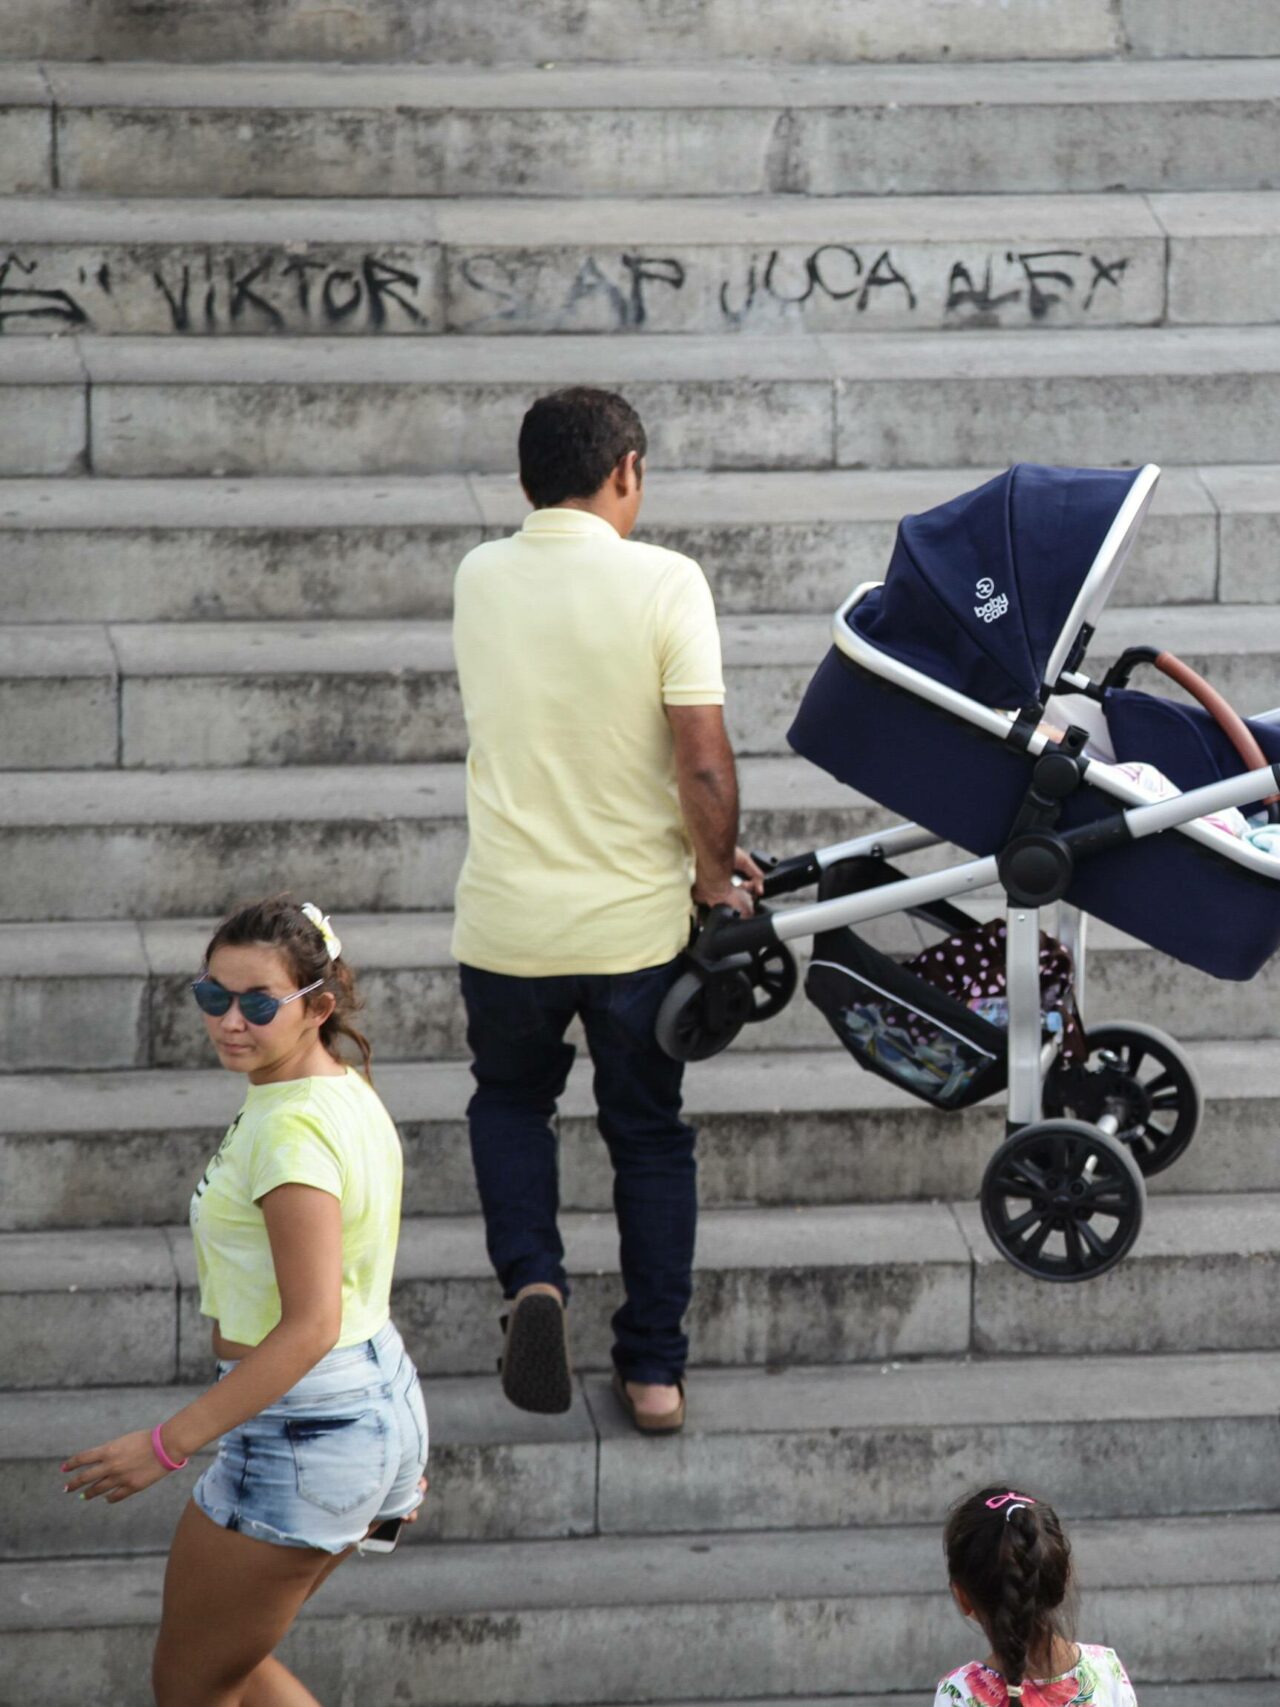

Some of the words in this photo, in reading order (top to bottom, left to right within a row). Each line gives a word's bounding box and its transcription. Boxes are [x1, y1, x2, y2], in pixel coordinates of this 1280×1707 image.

[152, 254, 428, 331] VIKTOR
[974, 593, 1009, 618] baby
[983, 604, 1008, 623] cab
